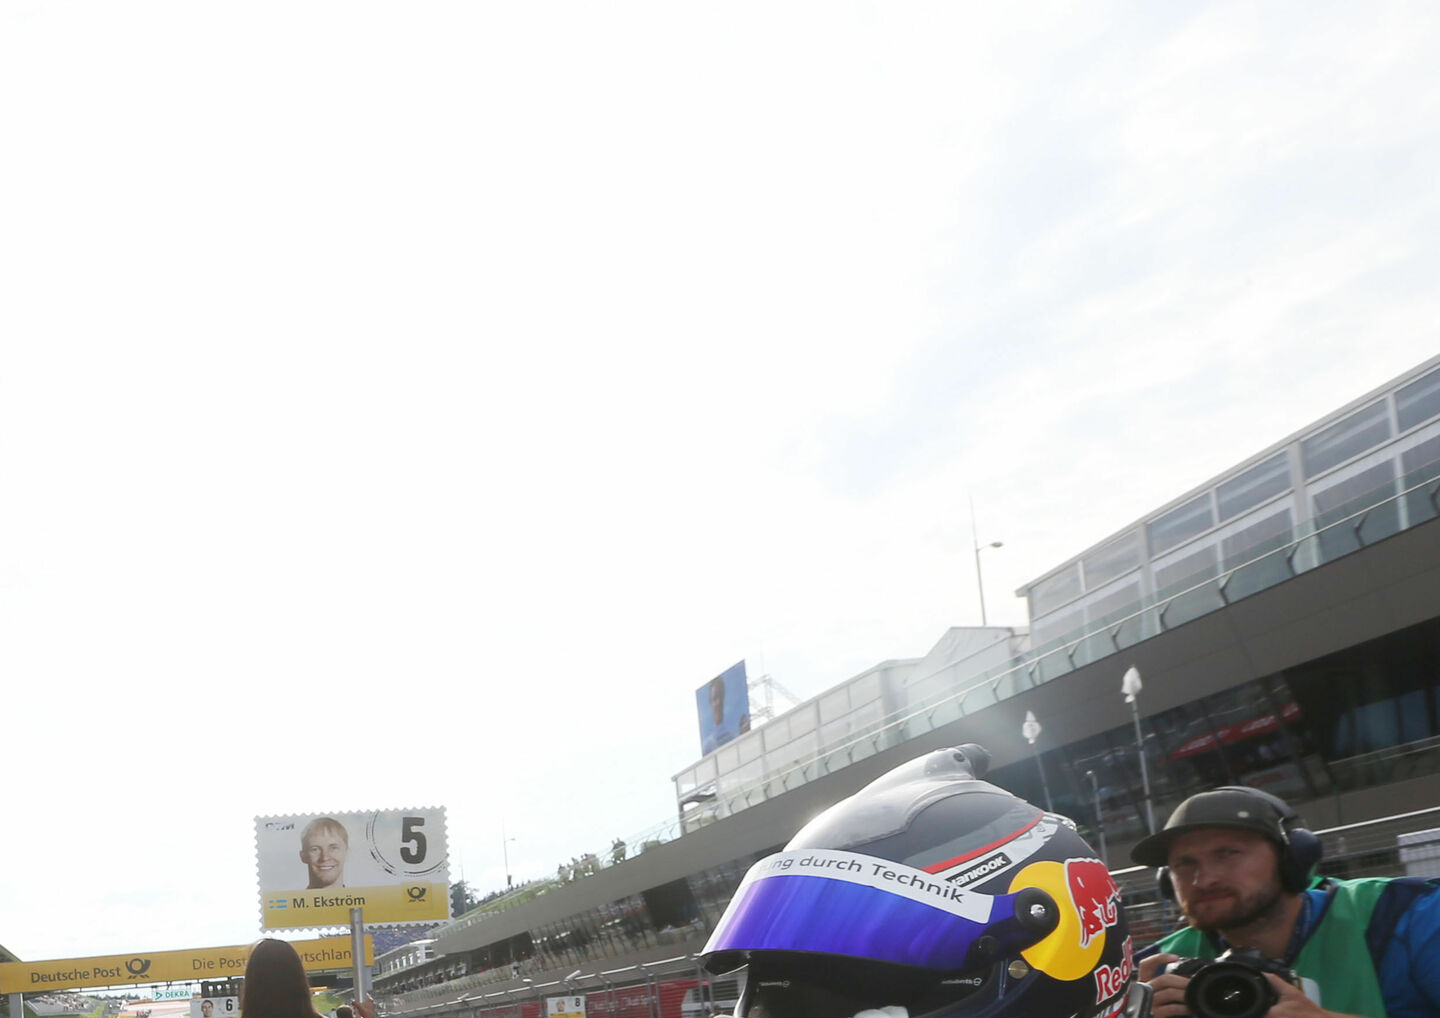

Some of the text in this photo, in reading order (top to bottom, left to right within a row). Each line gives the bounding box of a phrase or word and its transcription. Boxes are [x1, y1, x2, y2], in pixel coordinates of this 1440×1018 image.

[400, 817, 427, 865] 5
[800, 855, 863, 872] durch
[872, 863, 966, 903] Technik
[293, 895, 366, 909] M. Ekström
[192, 958, 215, 970] Die
[220, 957, 246, 969] Post
[31, 967, 121, 983] Deutsche Post
[165, 989, 190, 999] DEKRA
[225, 998, 233, 1012] 6
